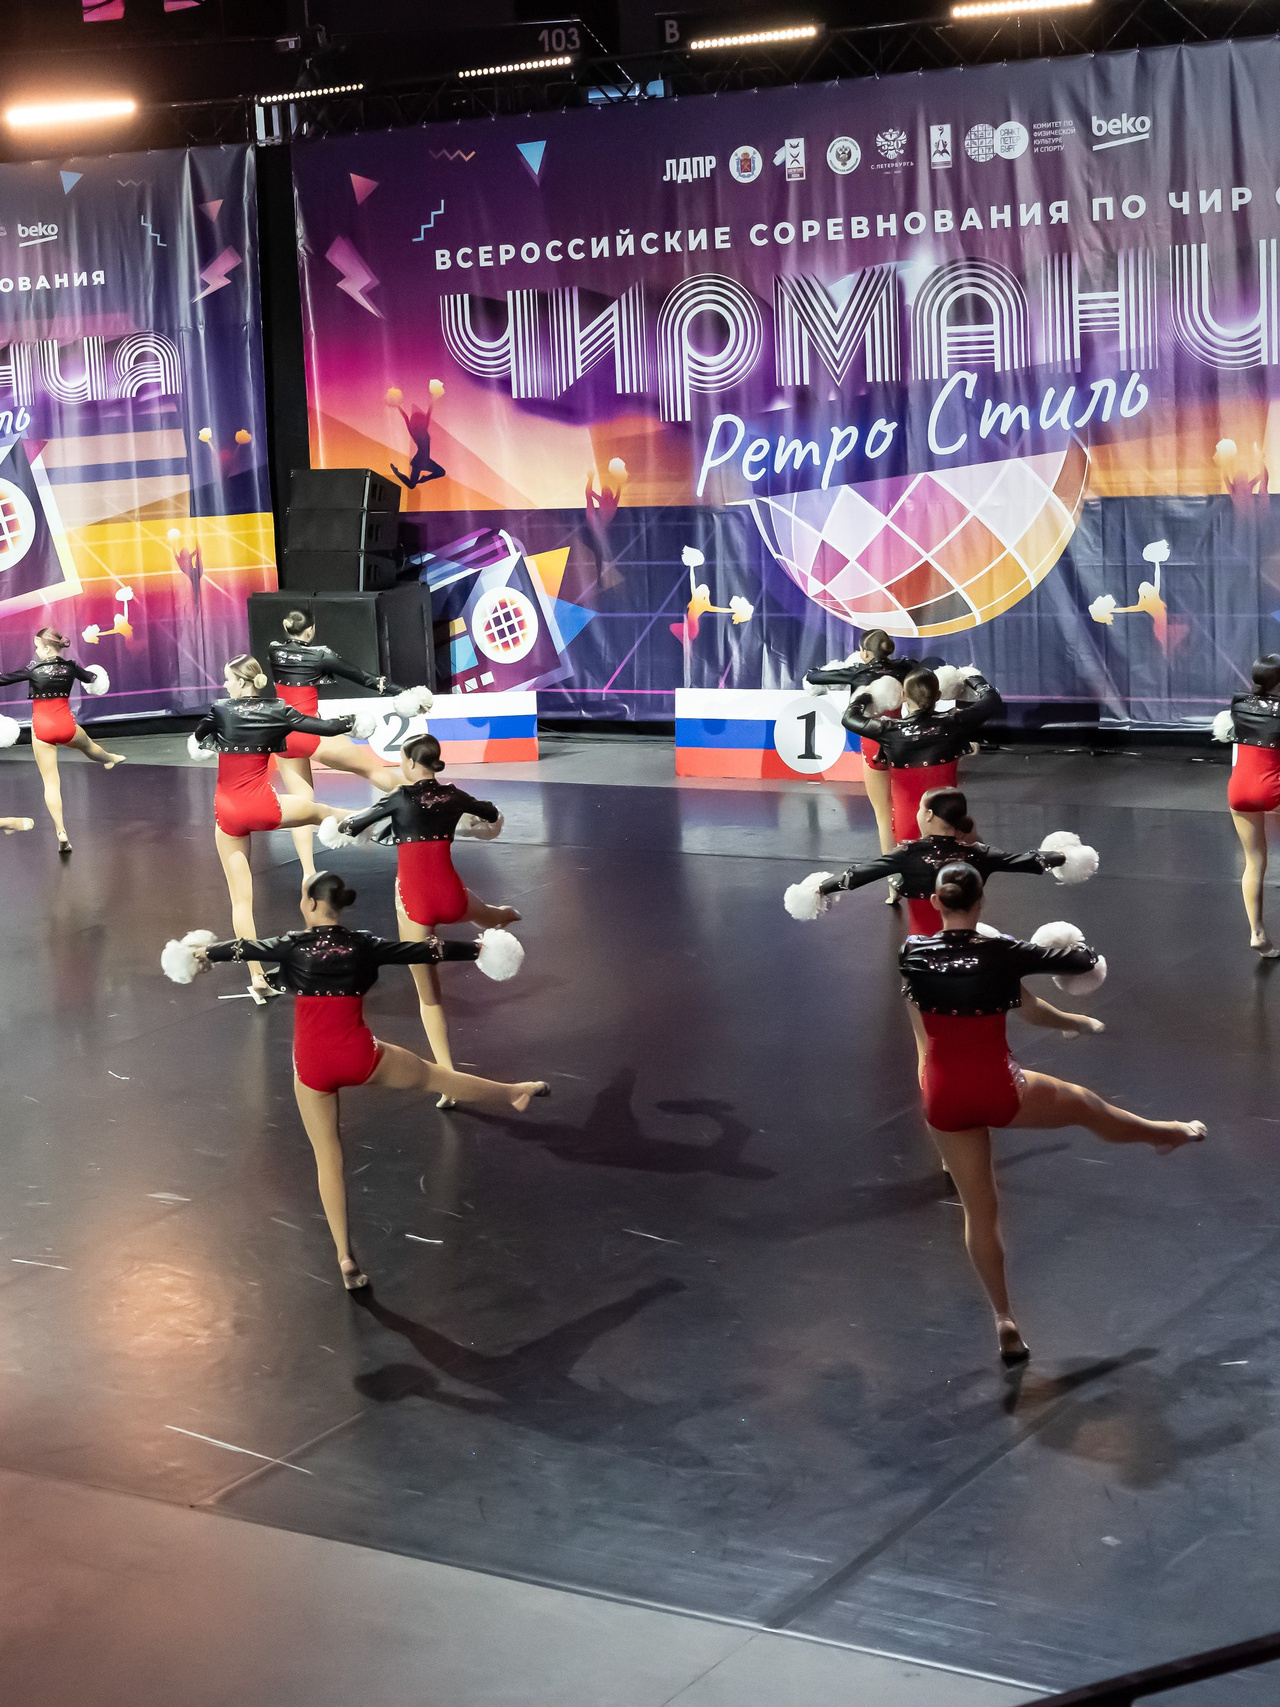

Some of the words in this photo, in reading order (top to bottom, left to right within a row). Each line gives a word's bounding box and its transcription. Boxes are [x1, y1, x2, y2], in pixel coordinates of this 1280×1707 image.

[537, 27, 581, 53] 103
[1091, 113, 1151, 137] beko
[662, 156, 716, 183] ЛДПР
[18, 222, 59, 237] beko
[434, 225, 733, 271] ВСЕРОССИЙСКИЕ
[748, 199, 1072, 246] СОРЕВНОВАНИЯ
[1092, 192, 1147, 220] ПО
[1169, 186, 1253, 214] ЧИР
[696, 413, 899, 499] Ретро
[926, 370, 1150, 457] Стиль
[382, 711, 411, 753] 2
[796, 710, 823, 760] 1
